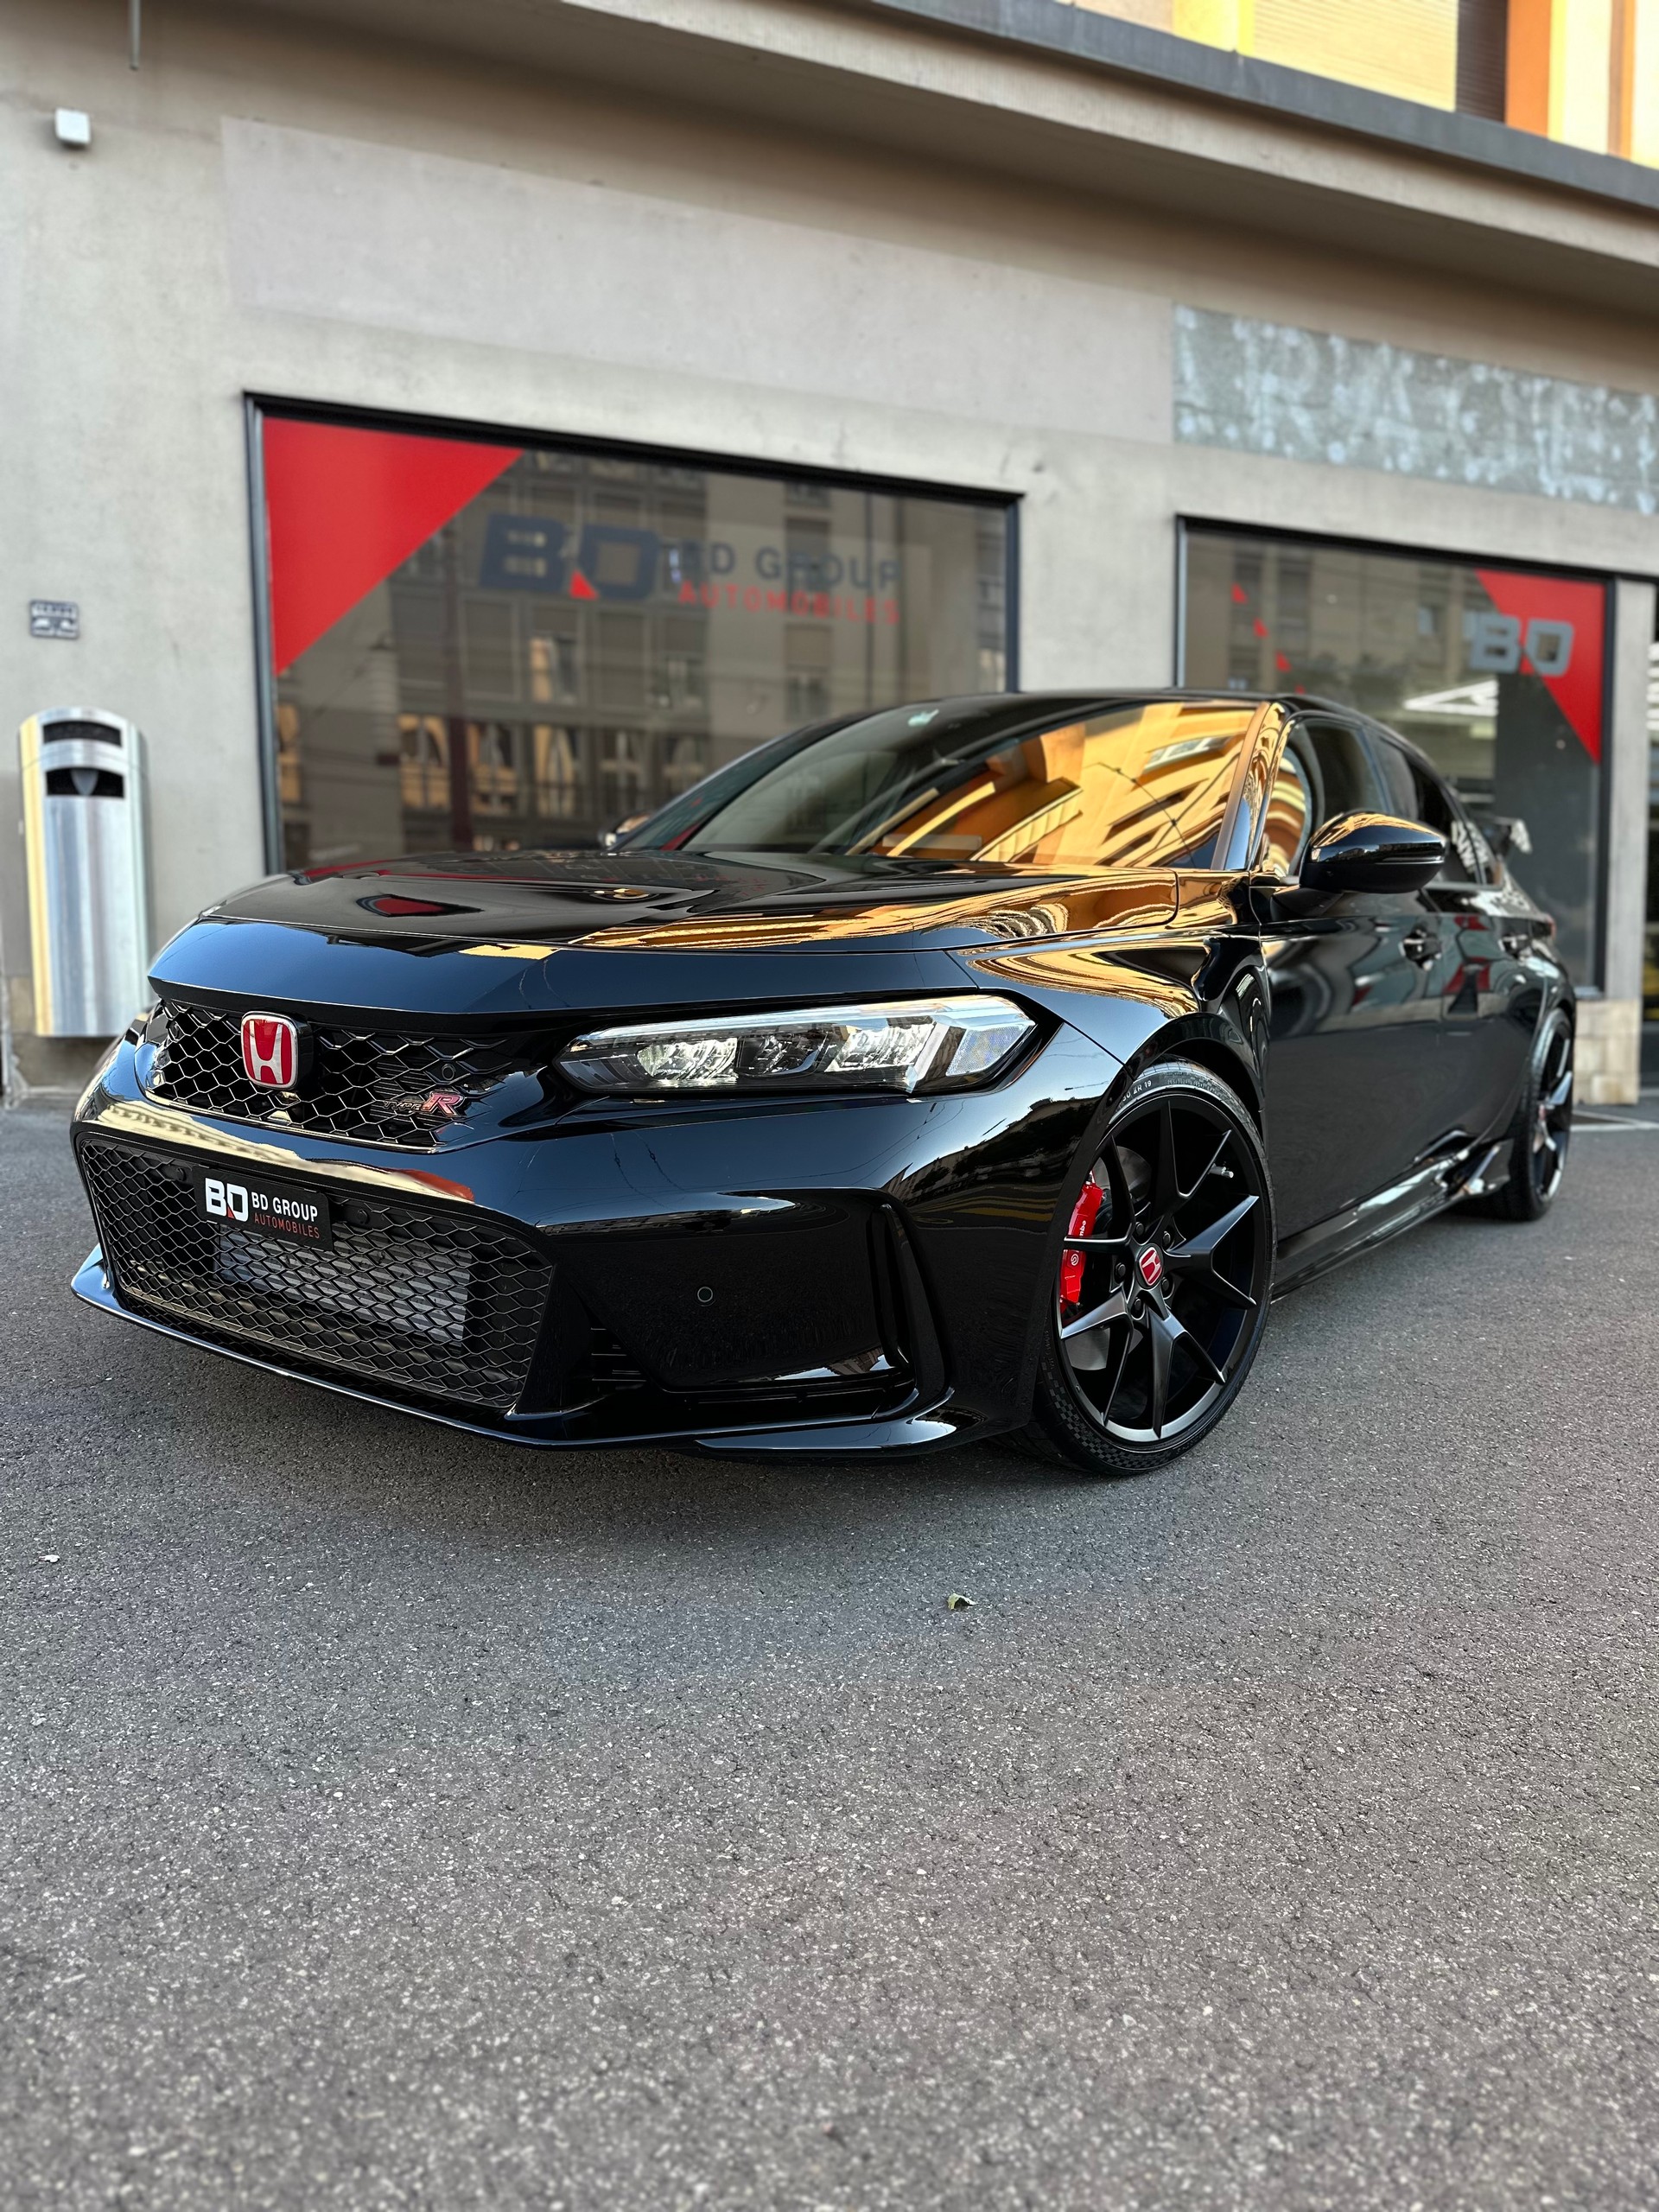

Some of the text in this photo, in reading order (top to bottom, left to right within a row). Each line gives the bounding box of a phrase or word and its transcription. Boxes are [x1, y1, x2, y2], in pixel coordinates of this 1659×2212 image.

[754, 546, 901, 591] GROUP
[678, 580, 900, 625] AUTOMOBILES
[421, 1090, 467, 1118] R
[251, 1192, 319, 1223] BD GROUP
[254, 1212, 321, 1239] AUTOMOBILES
